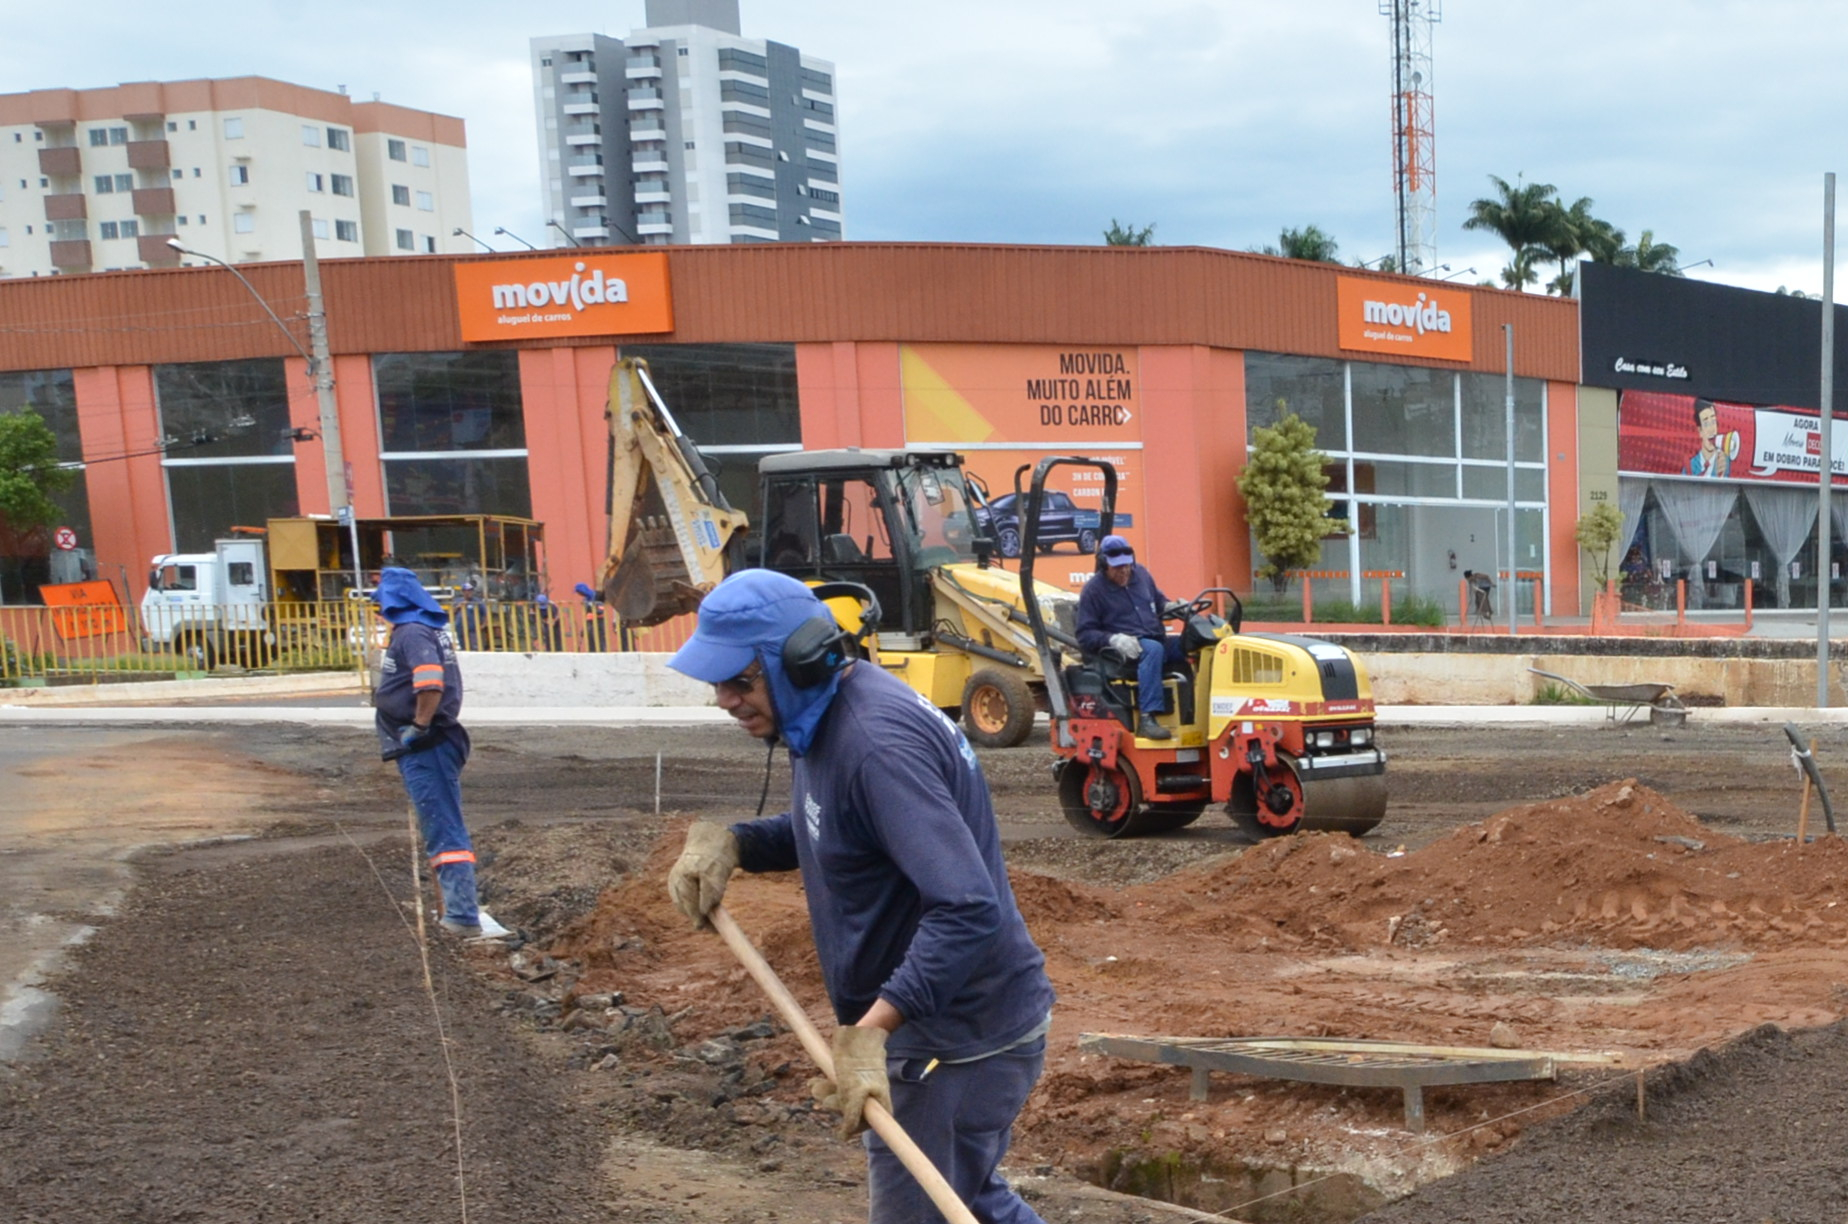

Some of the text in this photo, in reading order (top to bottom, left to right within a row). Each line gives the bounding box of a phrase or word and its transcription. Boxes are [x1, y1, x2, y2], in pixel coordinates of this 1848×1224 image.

[492, 262, 628, 311] movida
[498, 313, 572, 325] aluguel de carros
[1363, 292, 1452, 335] movida
[1363, 330, 1413, 342] aluguel de carros
[1060, 353, 1130, 374] MOVIDA.
[1027, 375, 1131, 400] MUITO ALÉM
[1041, 405, 1124, 426] DO CARRO
[1794, 418, 1818, 431] AGORA
[1763, 451, 1775, 462] EM
[1776, 453, 1801, 466] DOBRO
[1220, 643, 1228, 655] 3
